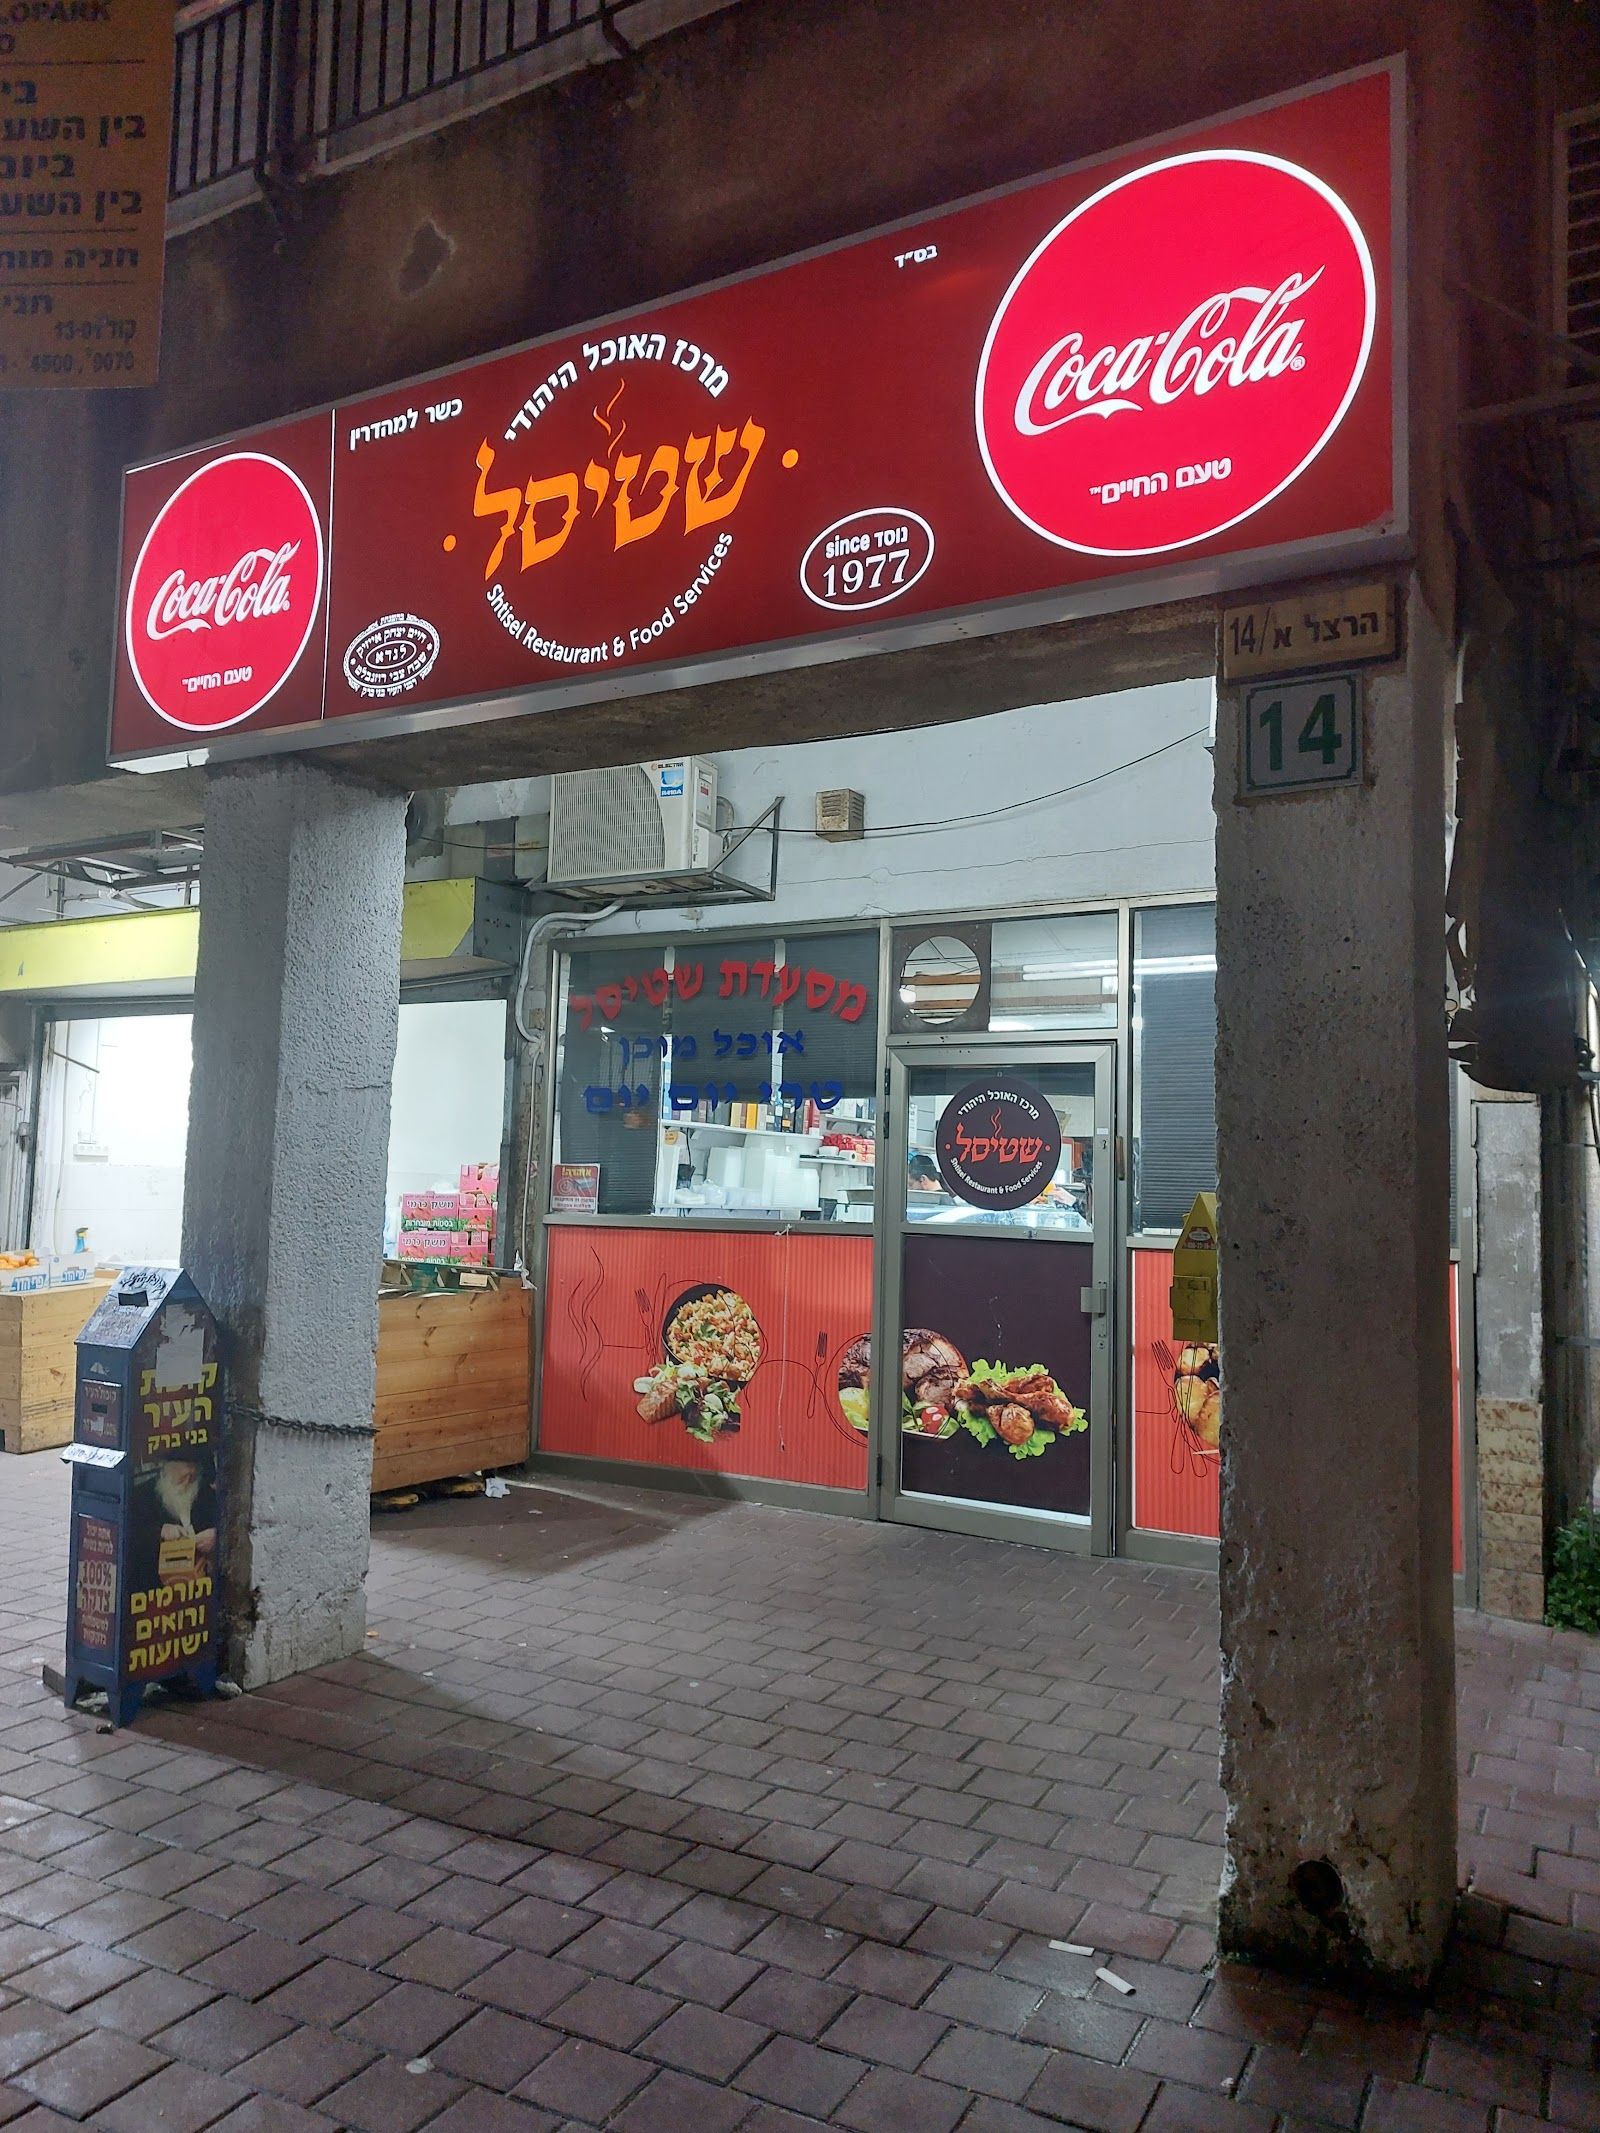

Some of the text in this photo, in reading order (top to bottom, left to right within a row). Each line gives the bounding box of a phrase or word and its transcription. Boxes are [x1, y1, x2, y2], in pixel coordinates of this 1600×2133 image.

[99, 115, 146, 148] בין
[94, 190, 143, 223] בין
[65, 248, 139, 269] חניה
[503, 332, 731, 443] מרכז האוכל היהודי
[350, 398, 463, 451] כשר למהדרין
[1175, 457, 1232, 489] טעם
[472, 415, 767, 582] שטיסל
[825, 526, 909, 560] since נוסד
[822, 548, 911, 599] 1977
[486, 531, 733, 665] Shtisel Restaurant & Food Services
[383, 626, 406, 643] יצחק
[407, 626, 427, 644] חיים
[1303, 611, 1379, 643] הרצל
[374, 643, 408, 665] לנדא
[406, 651, 428, 675] שבח
[223, 665, 253, 688] טעם
[389, 668, 406, 682] צבי
[1259, 693, 1342, 771] 14
[569, 959, 868, 1031] מסעדת שטיסל
[713, 1028, 806, 1057] אוכל
[583, 1080, 844, 1114] טרי יום יום
[957, 1089, 1040, 1121] מרכז האוכל היהודי
[955, 1122, 1043, 1164] שטיסל
[950, 1157, 1043, 1195] Shtisel Restaurant & Food Services
[407, 1199, 454, 1210] משק כרמי
[423, 1238, 446, 1248] משק
[140, 1361, 218, 1397] קת
[143, 1396, 212, 1428] העיר
[147, 1432, 182, 1455] ברק
[185, 1428, 208, 1445] בני
[82, 1559, 112, 1587] 100%
[81, 1587, 111, 1613] צדקה
[130, 1576, 212, 1616] תורמים
[135, 1604, 206, 1641] ורואים
[128, 1629, 209, 1672] ישועות
